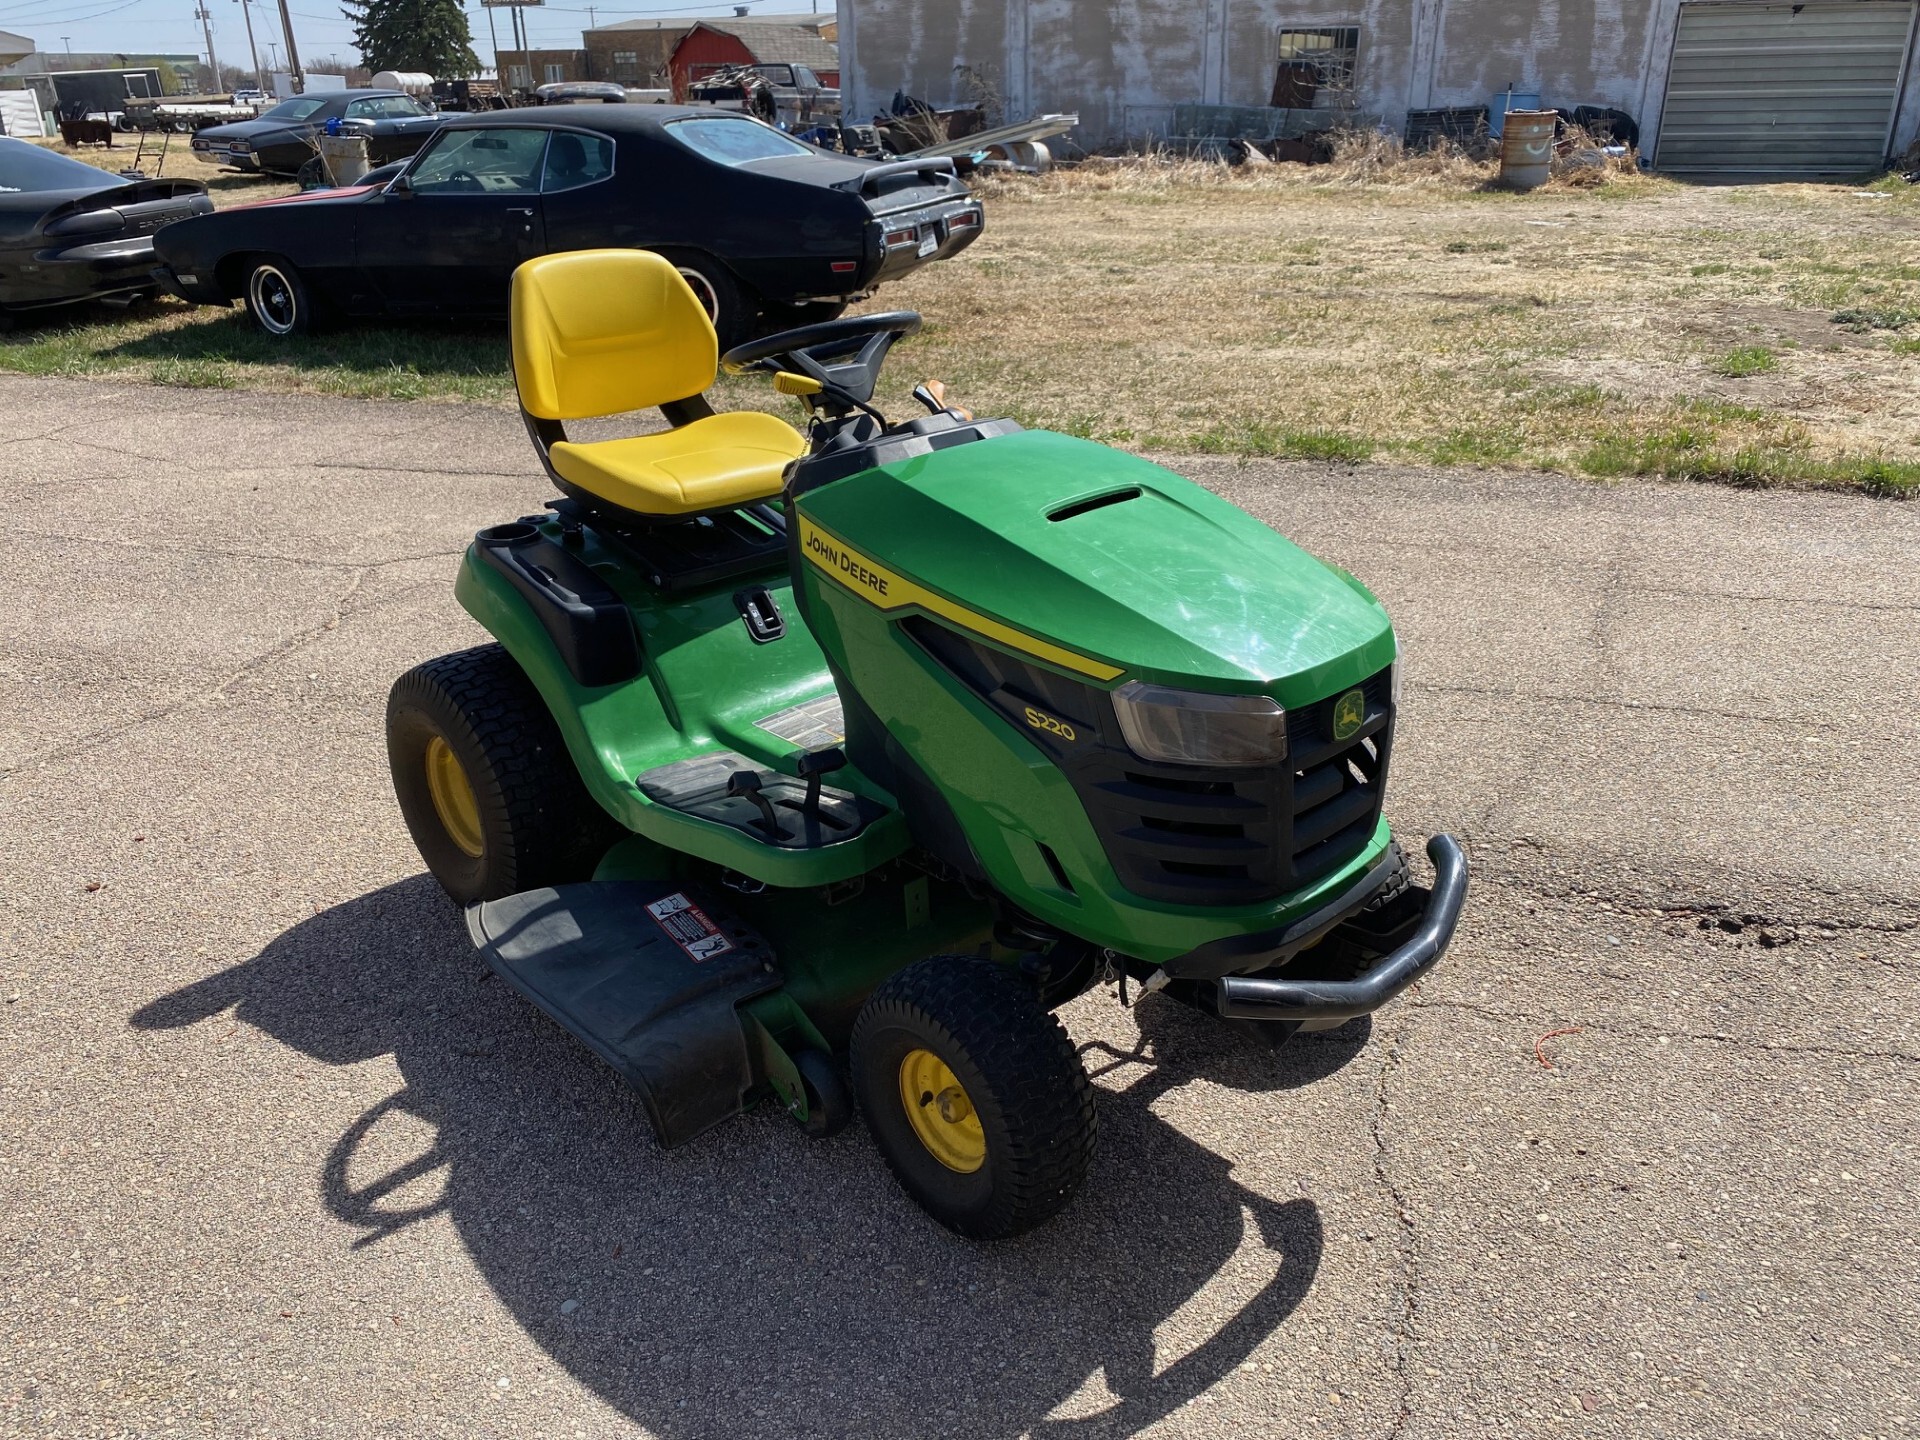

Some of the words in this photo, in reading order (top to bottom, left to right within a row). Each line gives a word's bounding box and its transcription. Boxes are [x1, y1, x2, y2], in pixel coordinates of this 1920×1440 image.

[806, 531, 838, 566] JOHN
[840, 552, 889, 597] DEERE
[1025, 706, 1076, 741] S220
